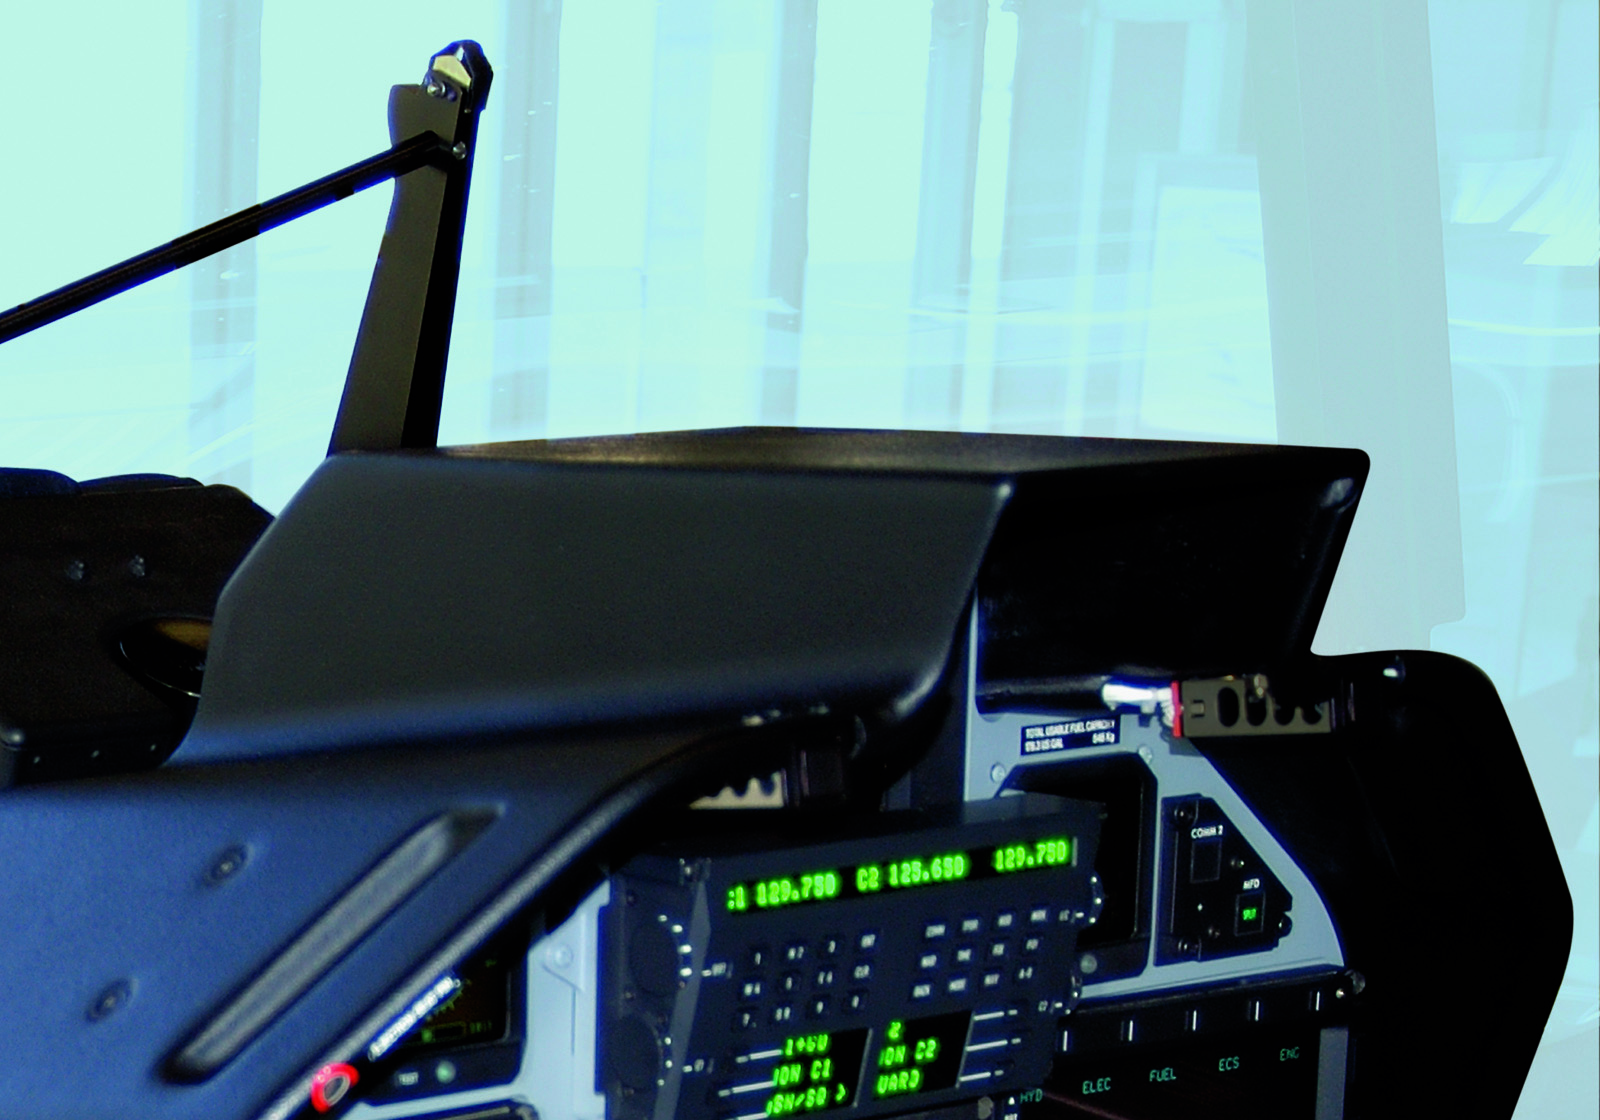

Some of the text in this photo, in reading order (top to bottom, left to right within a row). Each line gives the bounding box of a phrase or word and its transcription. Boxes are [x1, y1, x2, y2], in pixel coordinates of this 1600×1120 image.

[757, 840, 1068, 908] 129.750 C2 125.650 129.750
[915, 1038, 936, 1060] C2
[1280, 1047, 1299, 1061] ENG
[810, 1058, 831, 1080] C1
[1219, 1057, 1239, 1071] ECS
[1150, 1068, 1176, 1081] FUEL
[1083, 1078, 1111, 1094] ELEC
